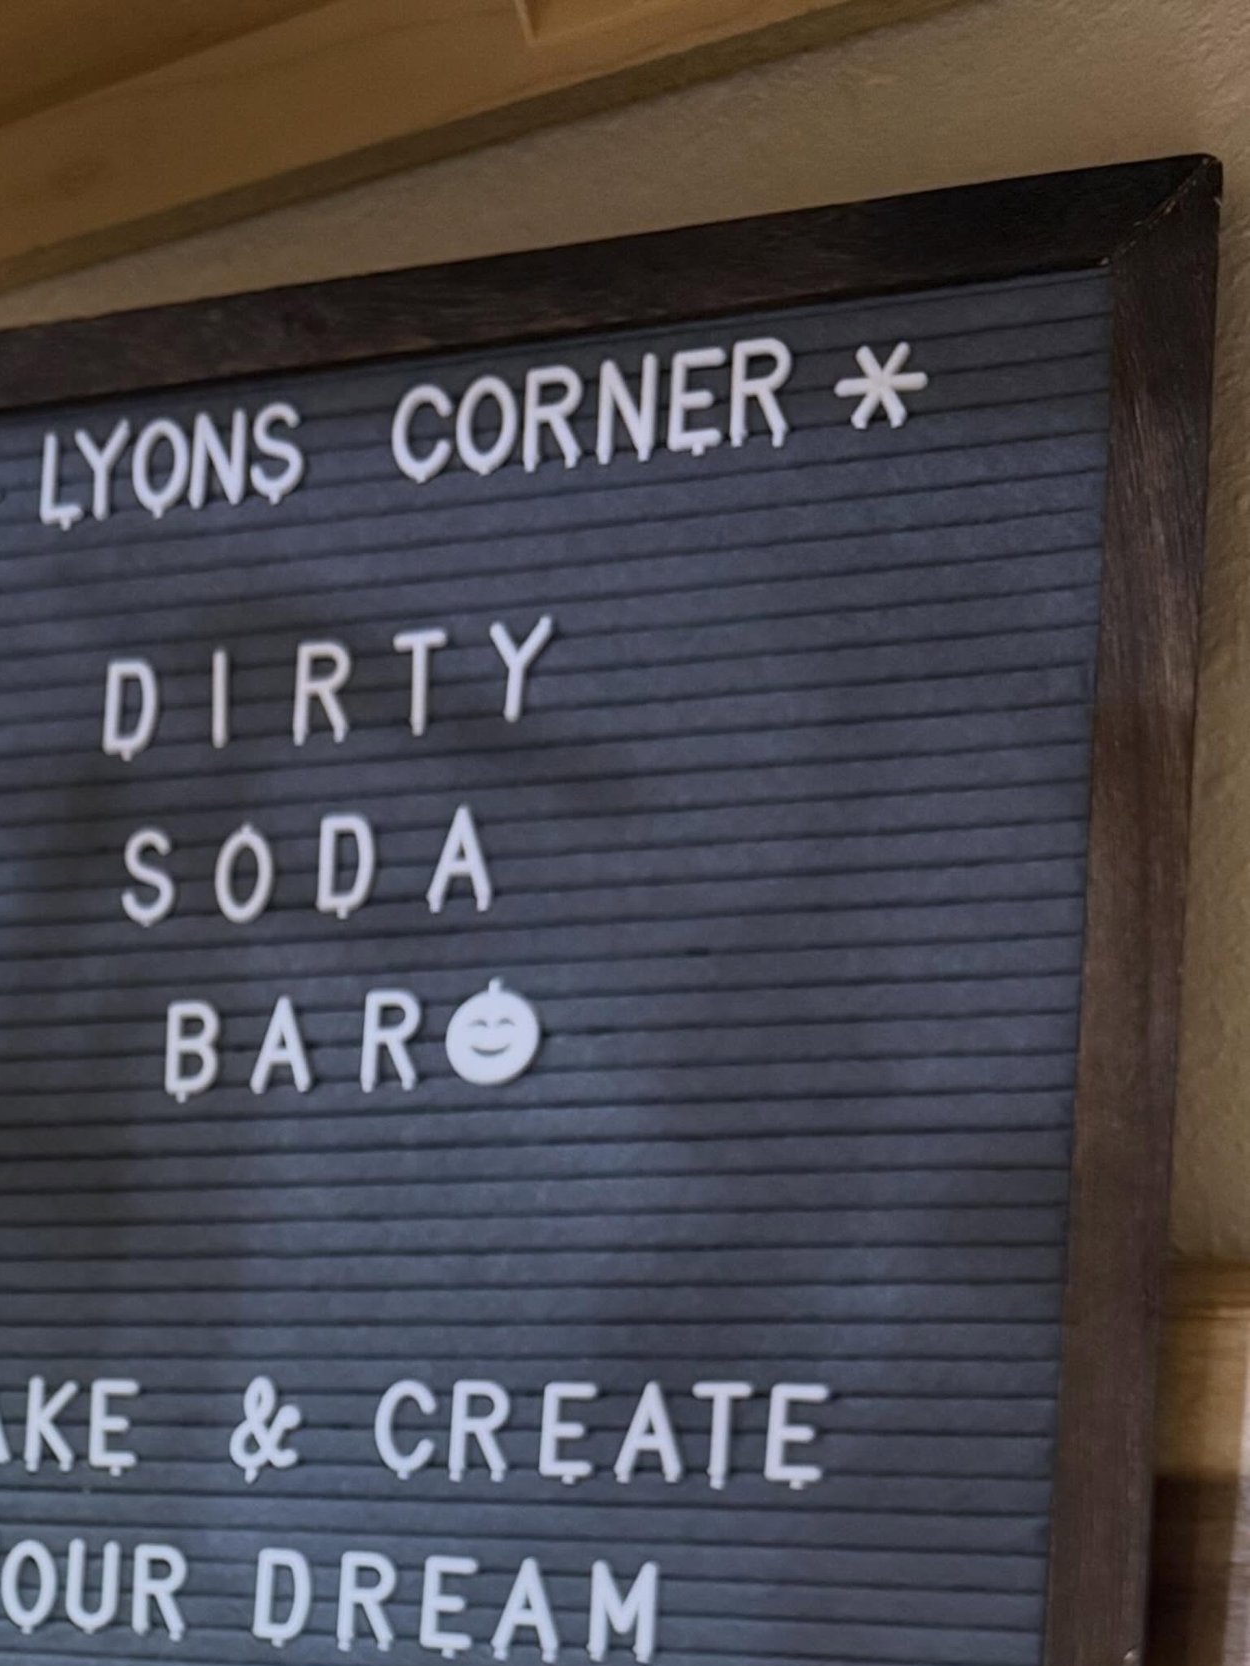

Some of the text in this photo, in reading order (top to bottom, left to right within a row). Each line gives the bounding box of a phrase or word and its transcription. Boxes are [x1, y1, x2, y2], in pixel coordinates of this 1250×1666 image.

[37, 337, 792, 531] LYONS CORNER
[101, 615, 553, 761] DIRTY
[121, 805, 494, 926] SODA
[163, 988, 419, 1103] BAR
[228, 1375, 300, 1483] &
[373, 1378, 830, 1490] CREATE
[251, 1547, 660, 1665] DREAM
